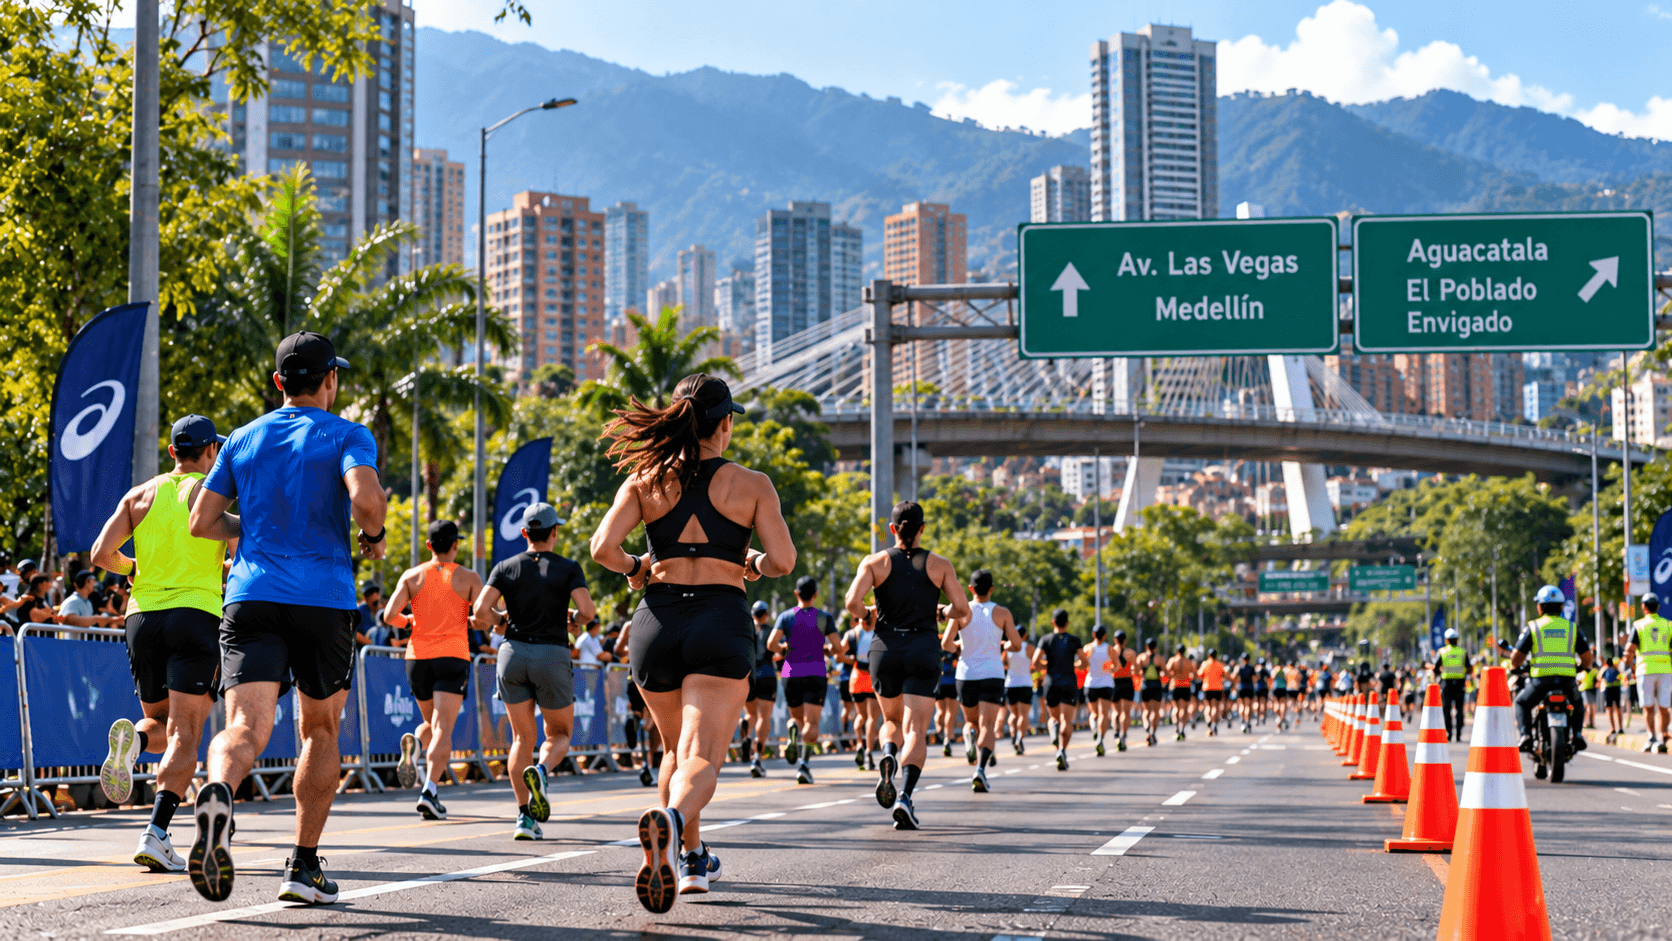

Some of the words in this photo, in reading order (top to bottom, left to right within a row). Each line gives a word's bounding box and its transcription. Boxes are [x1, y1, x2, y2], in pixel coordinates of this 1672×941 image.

[1118, 252, 1158, 276] Av.
[1168, 252, 1212, 276] Las
[1222, 251, 1299, 280] Vegas
[1407, 237, 1548, 269] Aguacatala
[1407, 278, 1430, 302] El
[1440, 277, 1537, 301] Poblado
[1156, 294, 1264, 321] Medellín
[1407, 310, 1513, 339] Envigado
